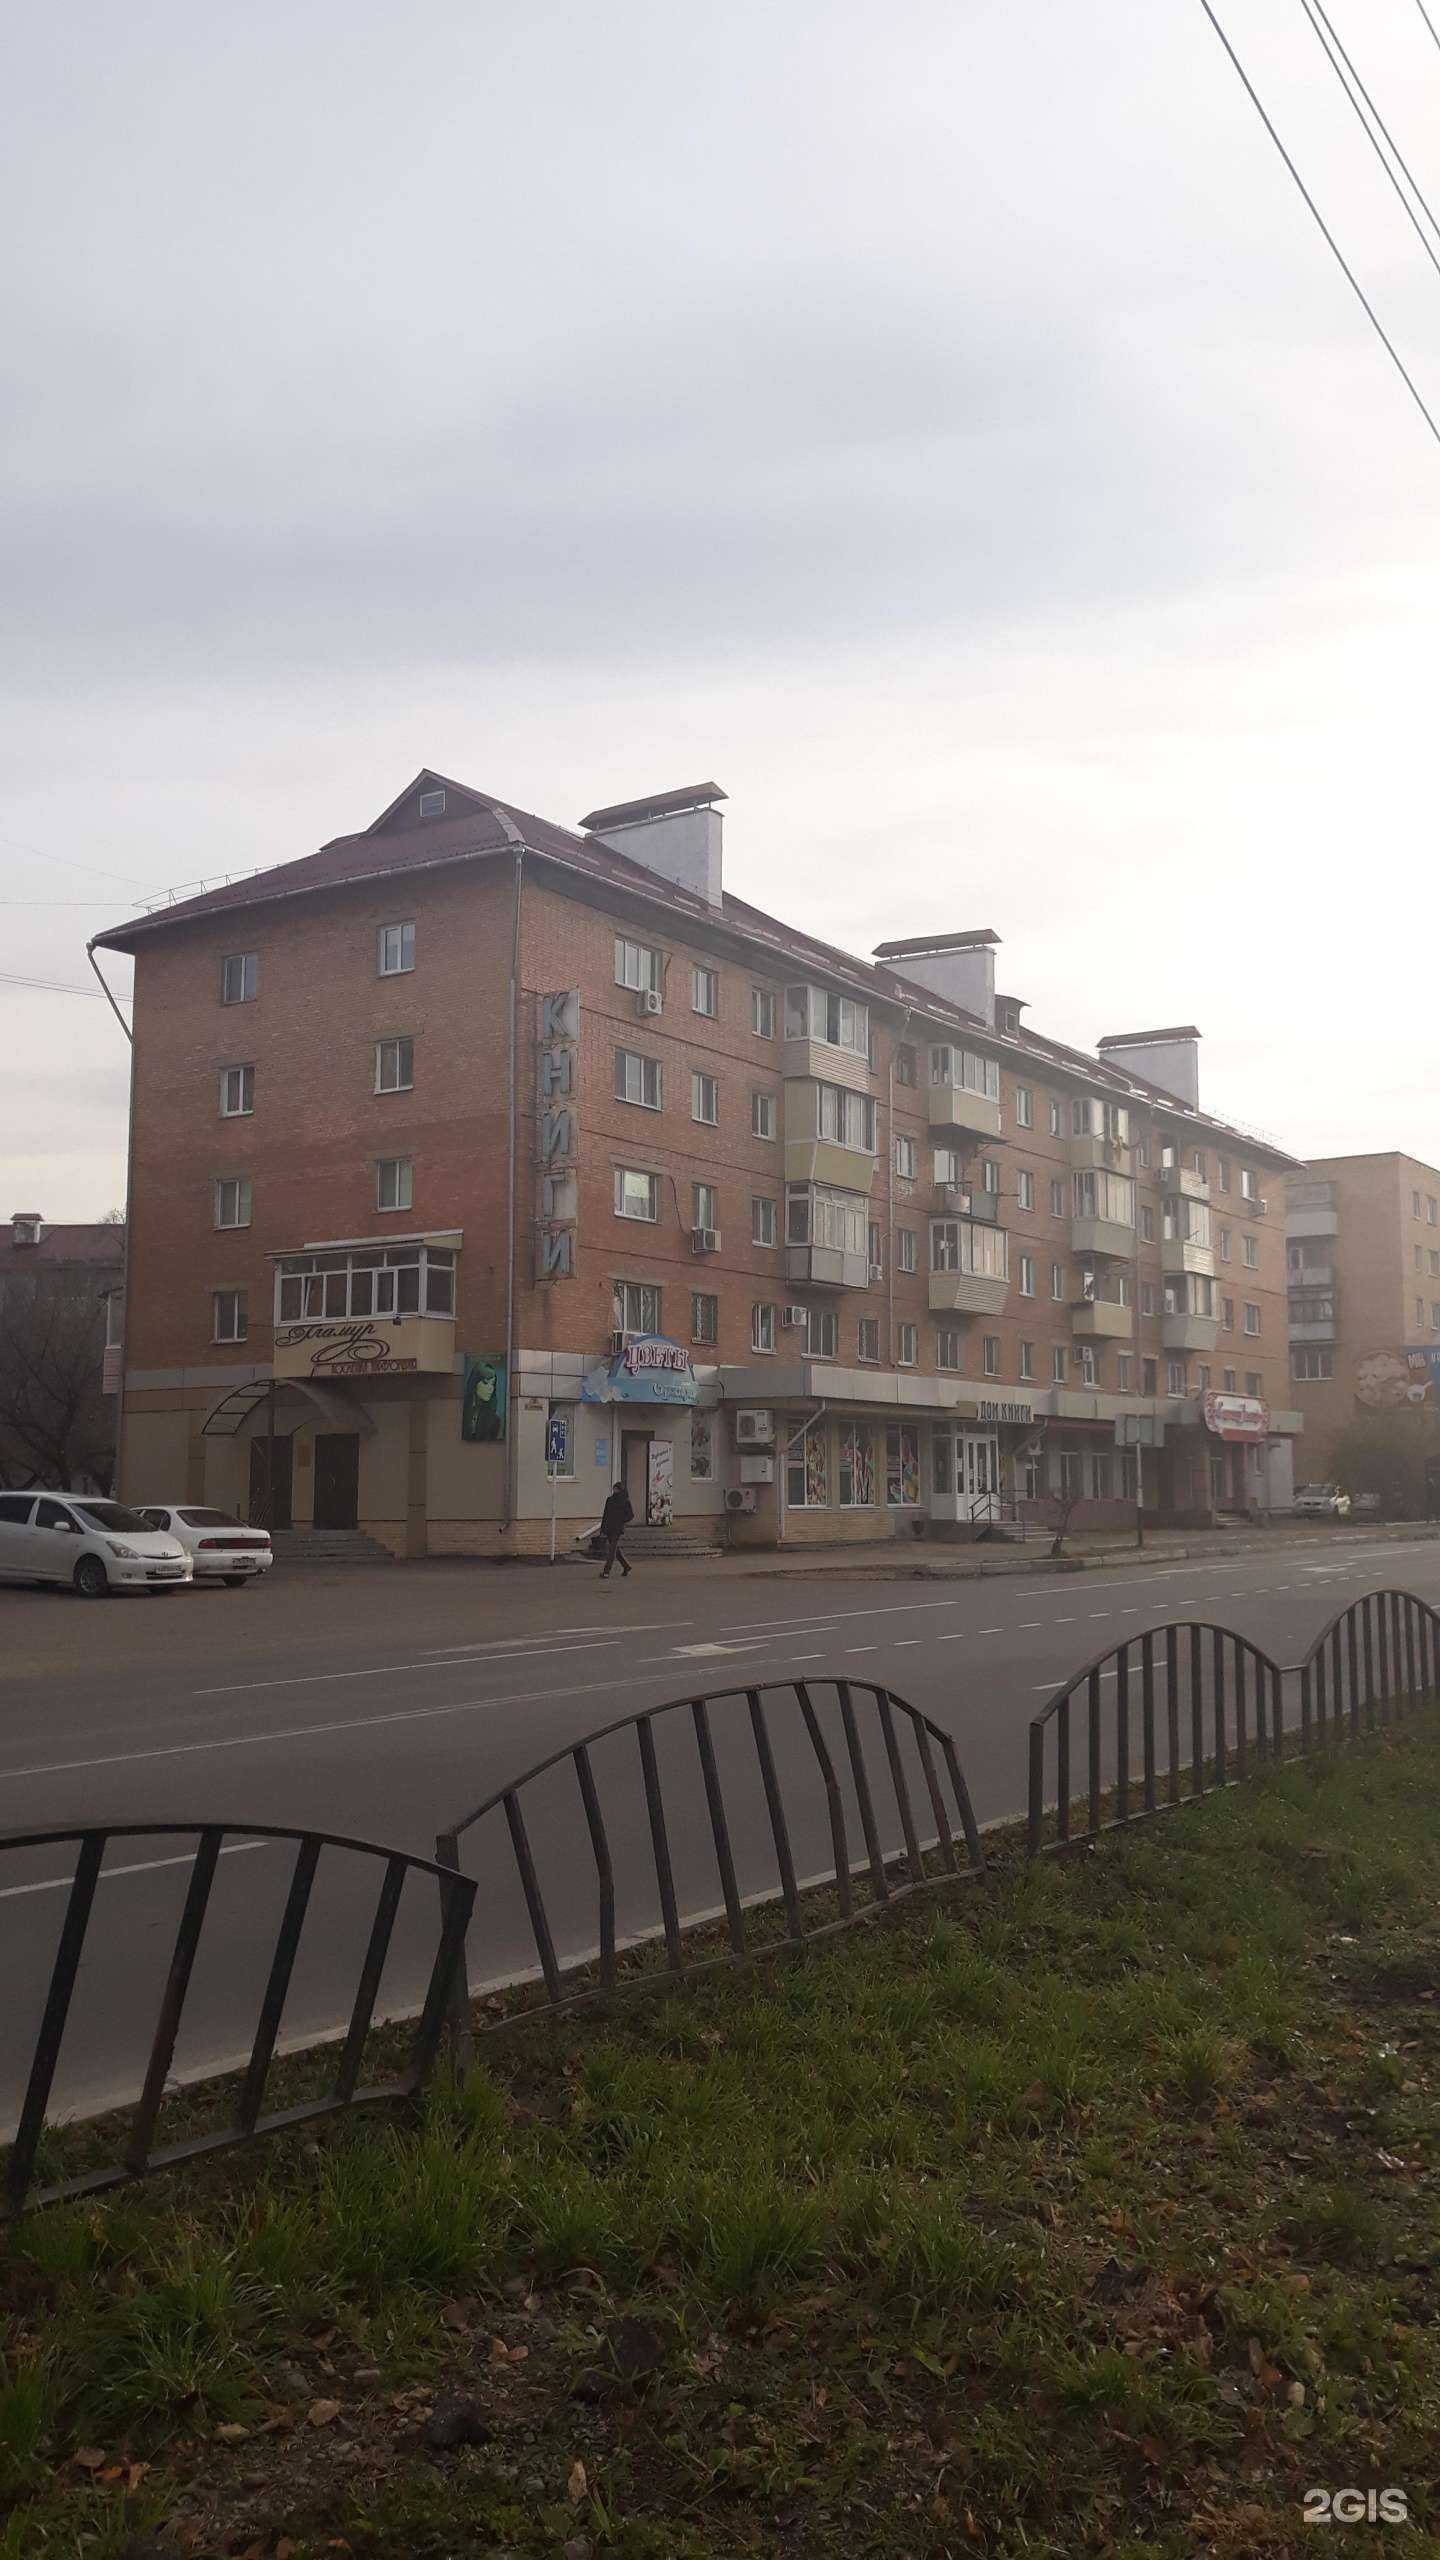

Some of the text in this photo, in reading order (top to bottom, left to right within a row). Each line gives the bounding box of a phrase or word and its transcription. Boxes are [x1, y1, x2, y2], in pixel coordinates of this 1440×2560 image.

[543, 991, 572, 1275] КНИГИ
[625, 1343, 689, 1376] ЦВЕТЫ
[980, 1401, 1031, 1422] ДОМ КНИГИ
